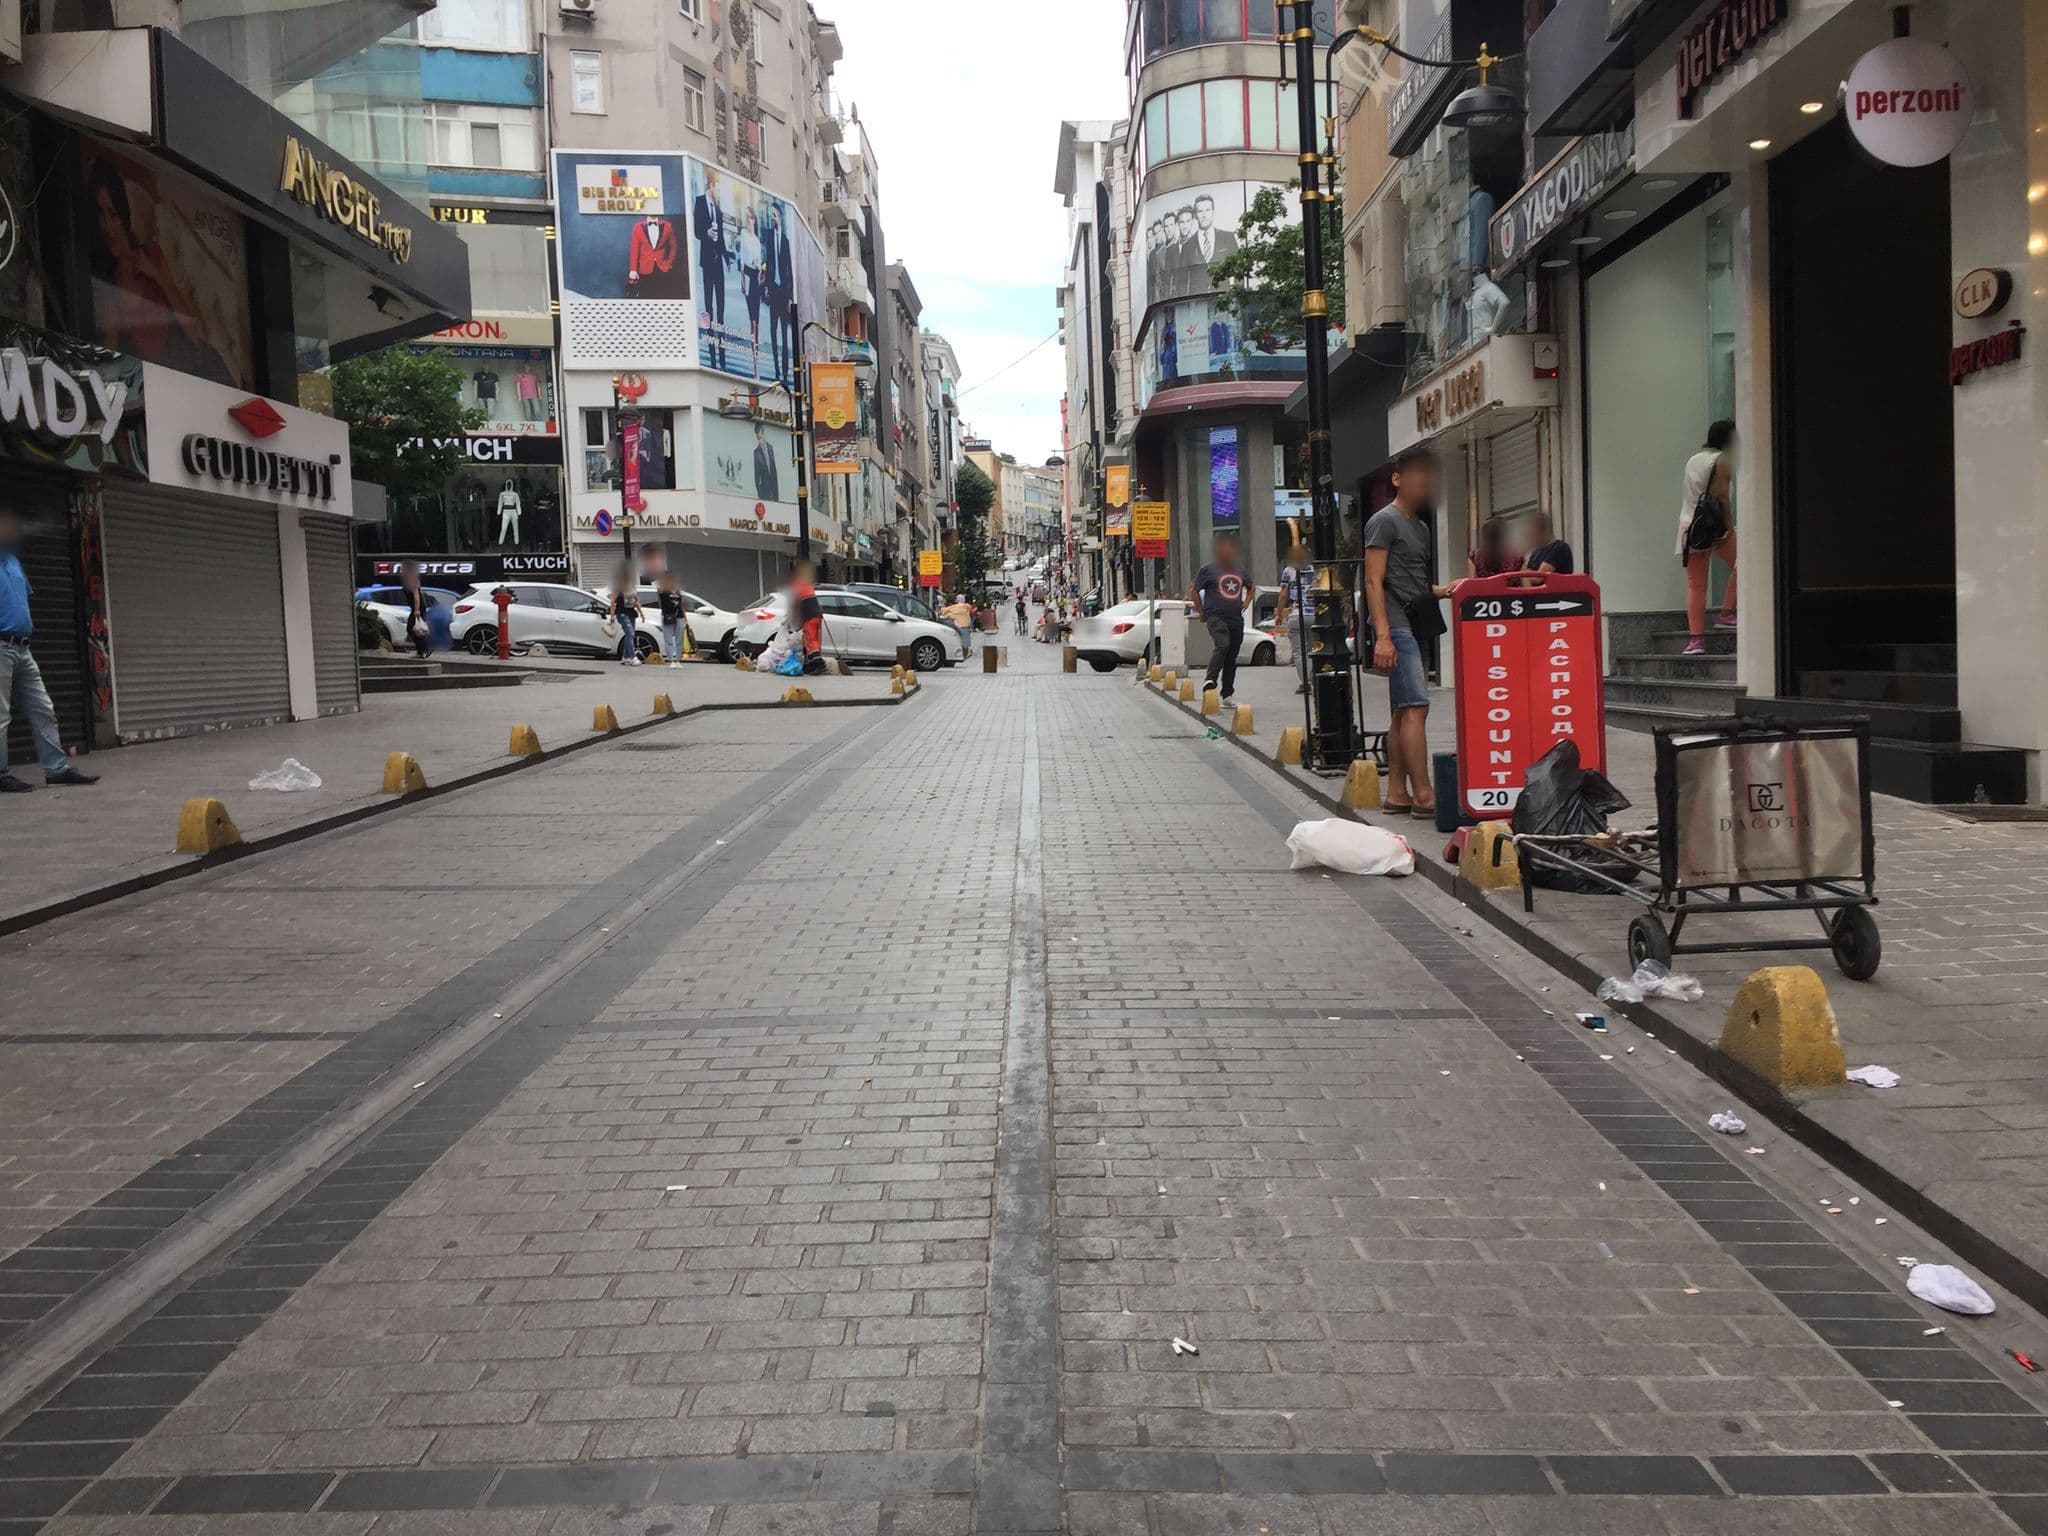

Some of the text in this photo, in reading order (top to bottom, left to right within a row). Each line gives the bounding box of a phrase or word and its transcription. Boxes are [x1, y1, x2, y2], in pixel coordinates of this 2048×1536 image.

[1856, 83, 1961, 120] perzoni
[582, 187, 605, 198] BIG
[496, 422, 516, 431] 6XL
[519, 423, 538, 432] 7XL
[181, 433, 337, 501] GUIDETTI
[639, 514, 700, 526] MILANO
[729, 517, 791, 535] MARCO MILANO
[503, 556, 567, 569] KLYUCH
[1474, 600, 1524, 618] 20 $
[1548, 622, 1574, 744] РАСПРОД
[1486, 624, 1512, 785] DISCOUNT
[1482, 791, 1508, 806] 20
